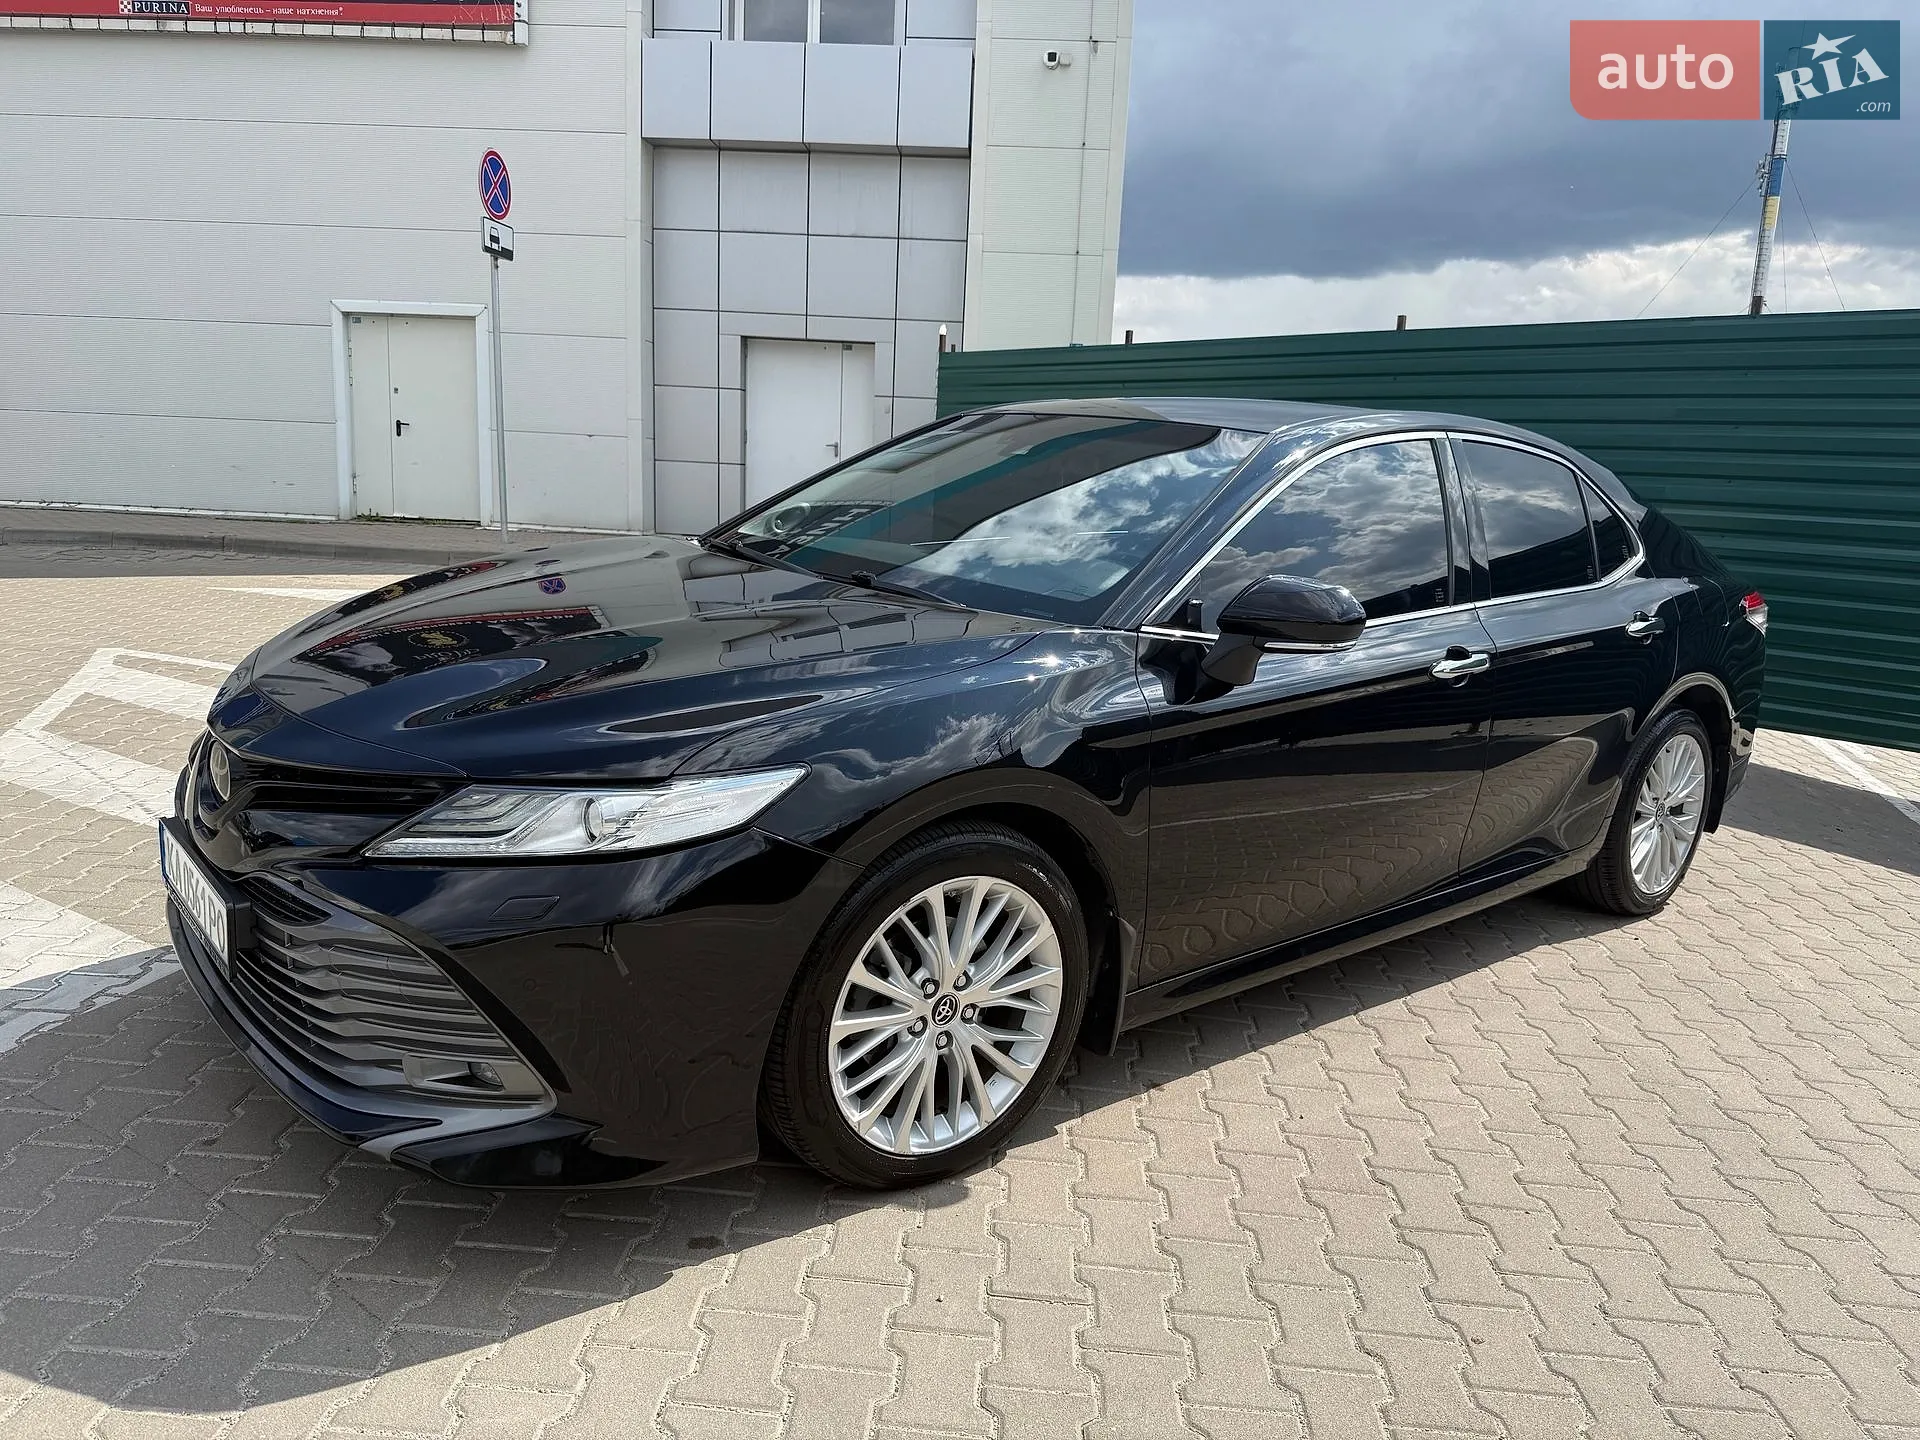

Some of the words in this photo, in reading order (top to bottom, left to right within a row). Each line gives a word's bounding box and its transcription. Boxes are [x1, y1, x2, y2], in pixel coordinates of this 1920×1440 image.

[134, 2, 188, 14] PURINA
[195, 4, 213, 13] Ваш
[215, 5, 264, 15] улюбленець
[272, 7, 294, 15] наше
[183, 861, 207, 931] 0561
